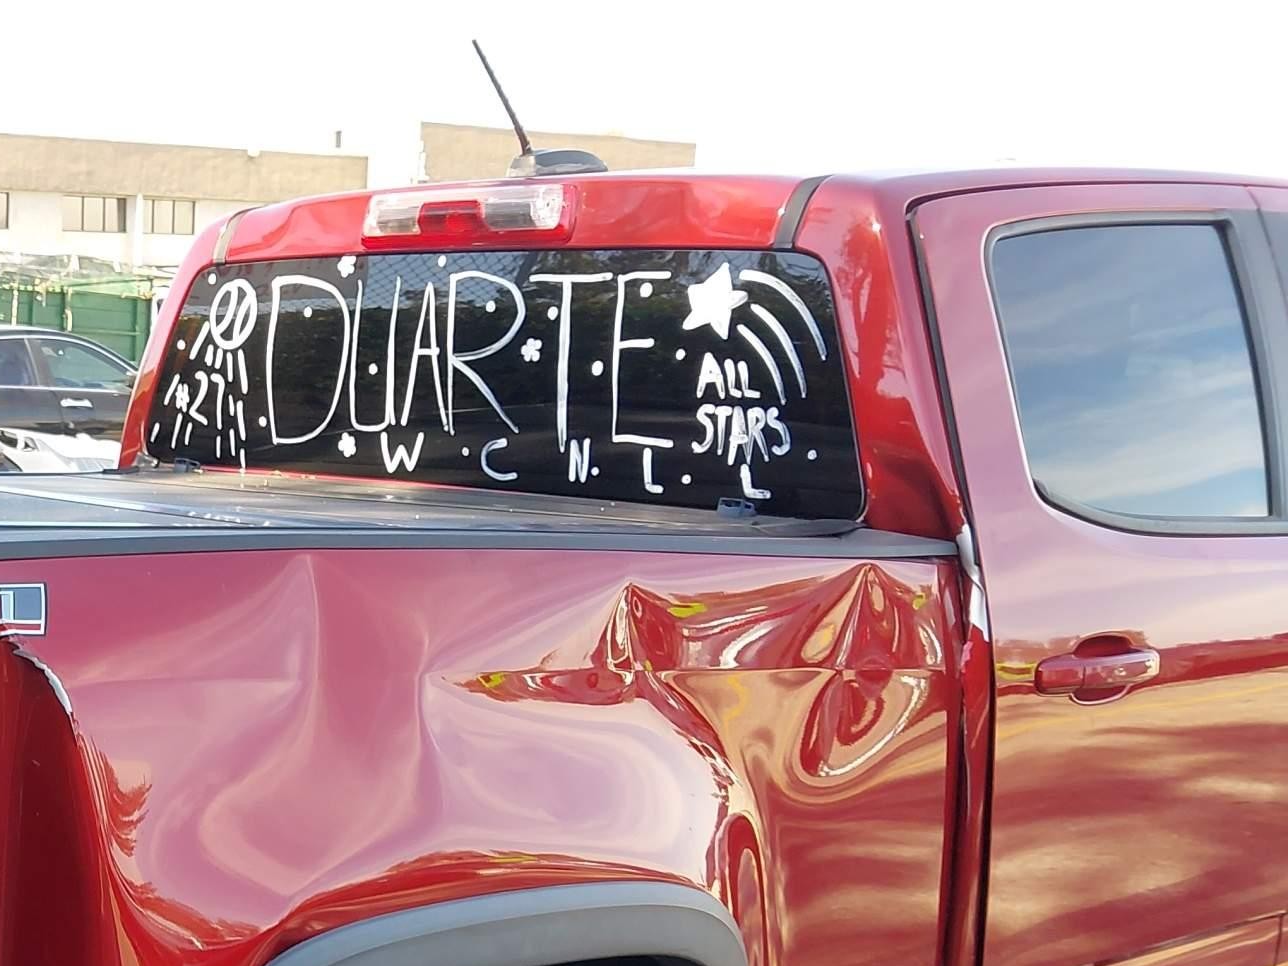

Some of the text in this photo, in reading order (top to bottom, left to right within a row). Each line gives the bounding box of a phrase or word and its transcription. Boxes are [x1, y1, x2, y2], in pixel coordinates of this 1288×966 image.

[266, 270, 674, 453] DUARTE
[696, 352, 761, 399] ALL
[692, 404, 791, 466] STARS
